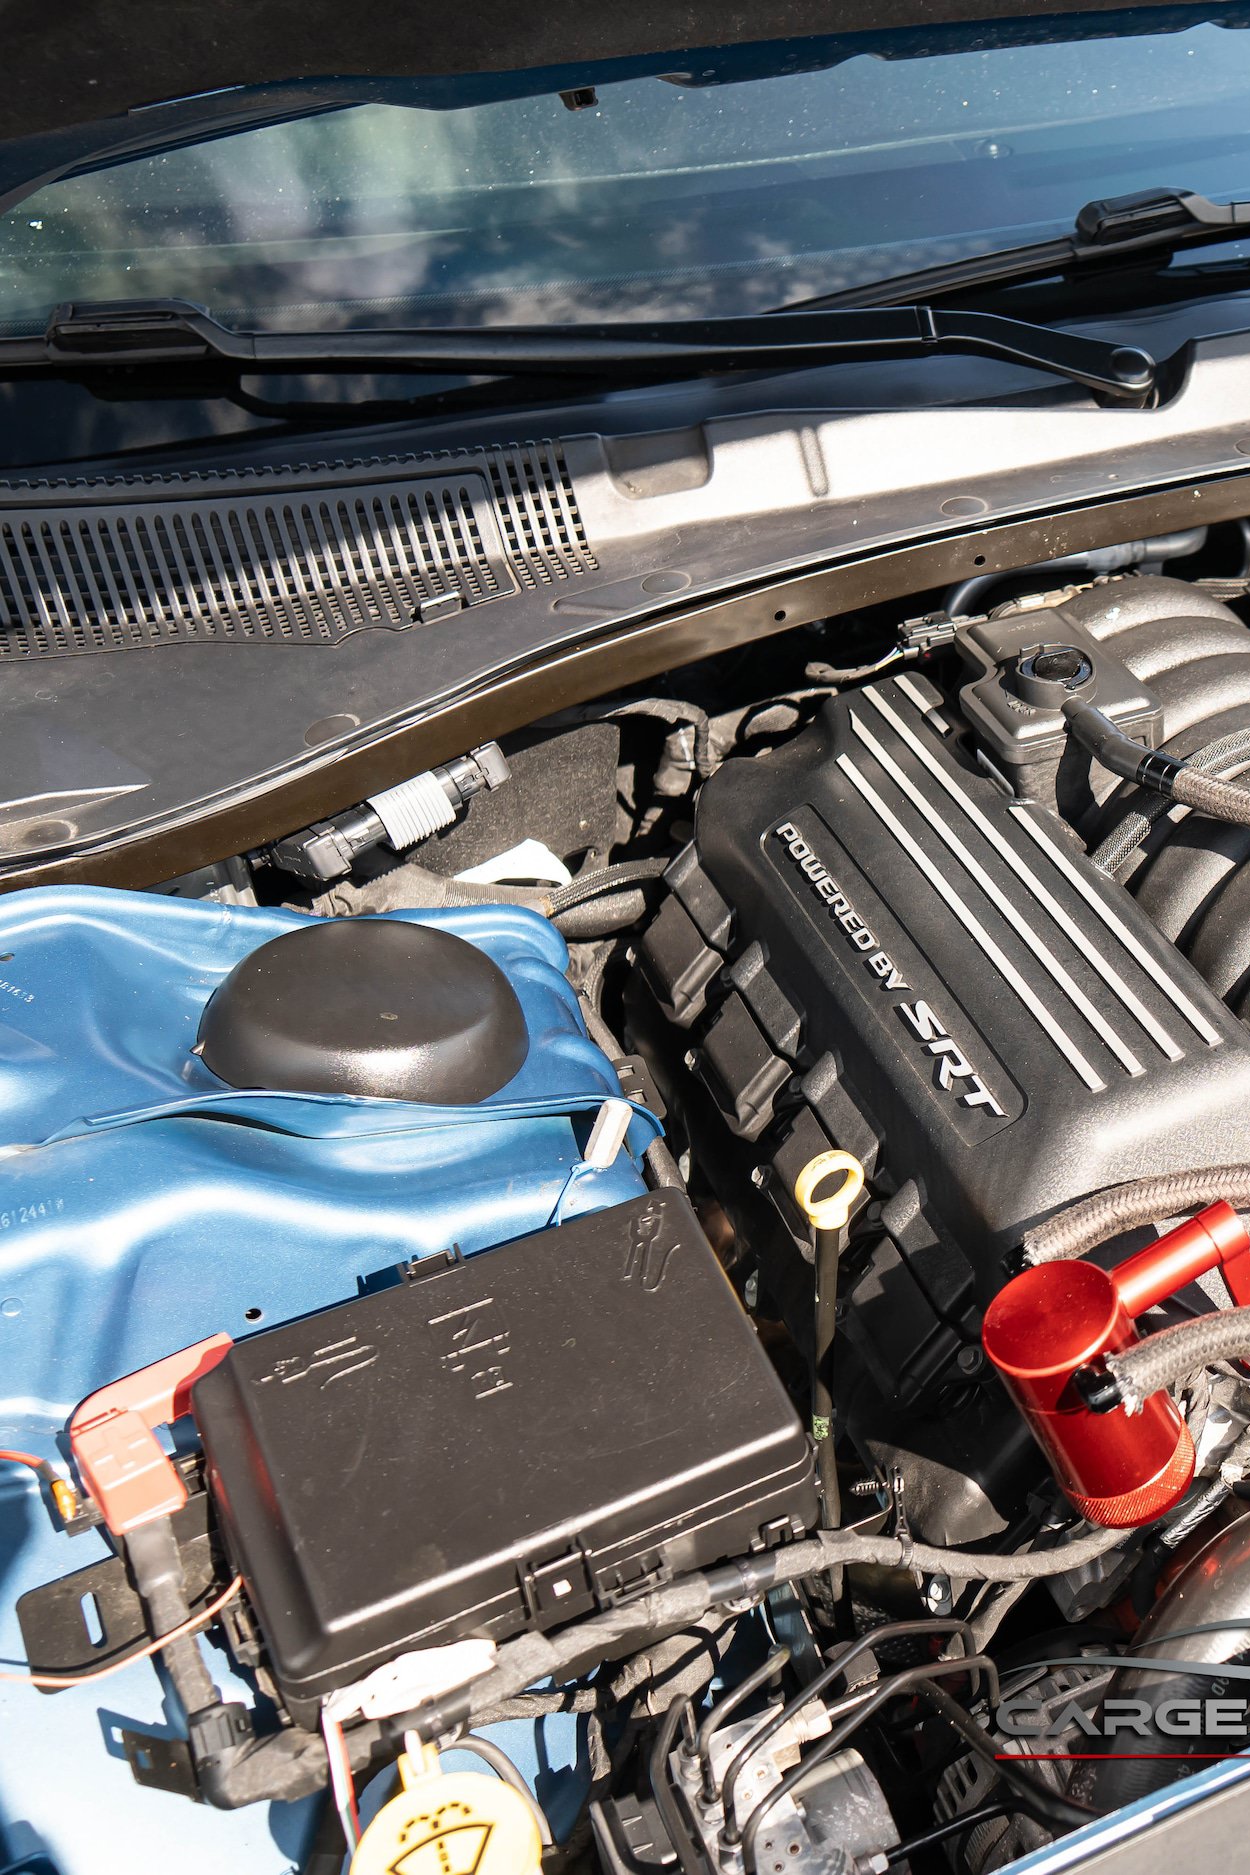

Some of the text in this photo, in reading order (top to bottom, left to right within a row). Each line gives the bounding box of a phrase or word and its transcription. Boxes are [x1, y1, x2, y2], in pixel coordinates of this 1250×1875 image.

[775, 821, 1009, 1118] POWERED BY SRT
